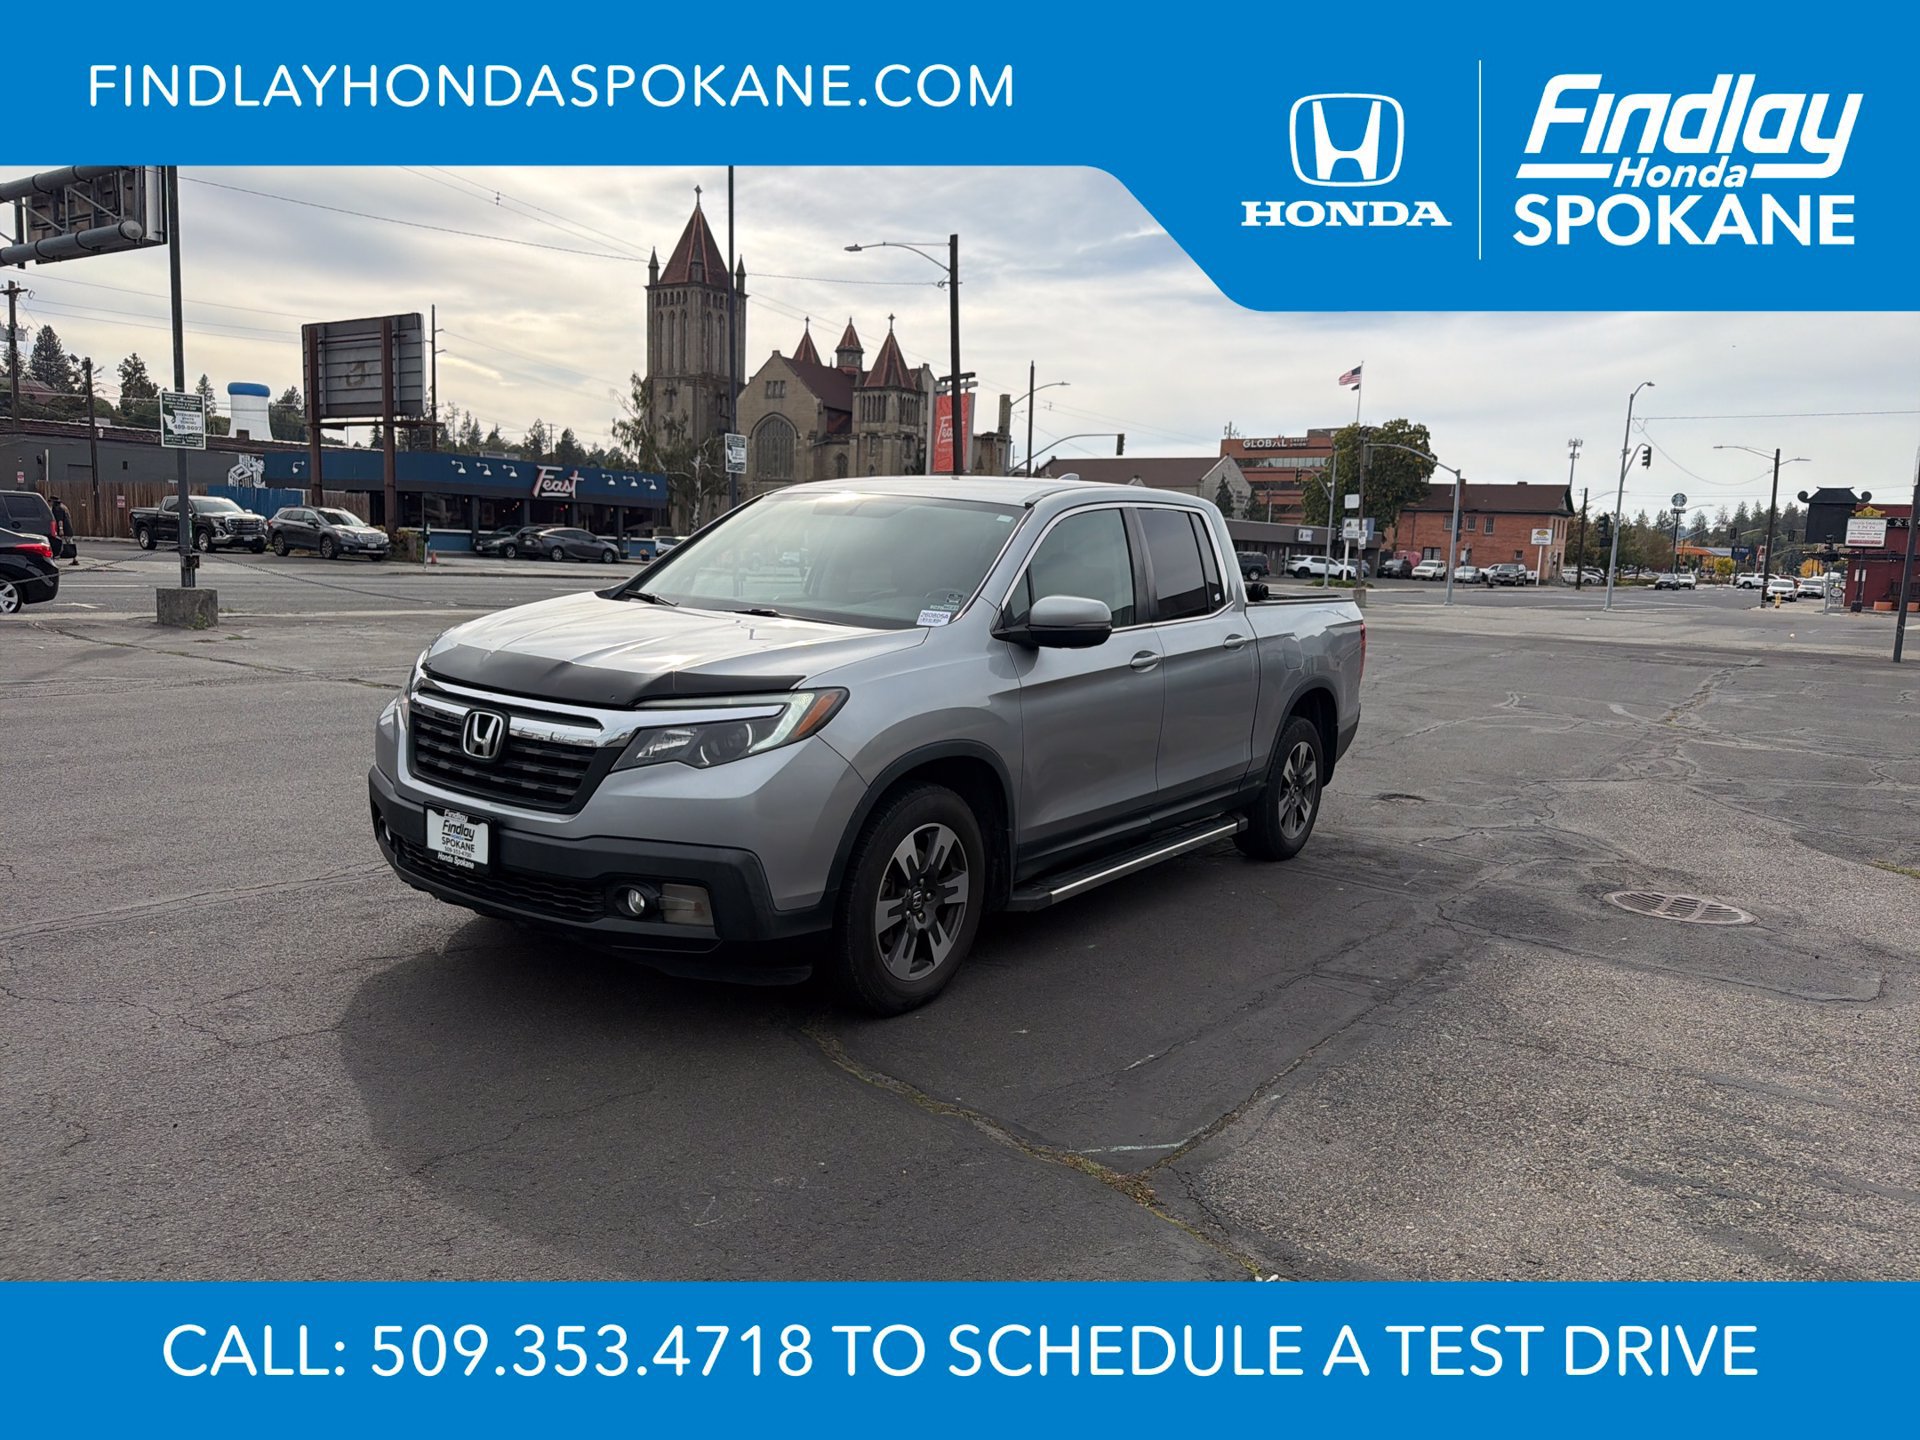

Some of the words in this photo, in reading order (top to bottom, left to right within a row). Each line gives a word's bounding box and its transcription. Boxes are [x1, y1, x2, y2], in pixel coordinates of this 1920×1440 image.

[937, 415, 966, 445] Fea
[1242, 438, 1288, 448] GLOBAL
[532, 465, 585, 499] Feast
[442, 819, 476, 842] Findlay
[441, 836, 475, 853] SPOKANE
[437, 851, 454, 864] Honda
[453, 856, 475, 870] Spokane
